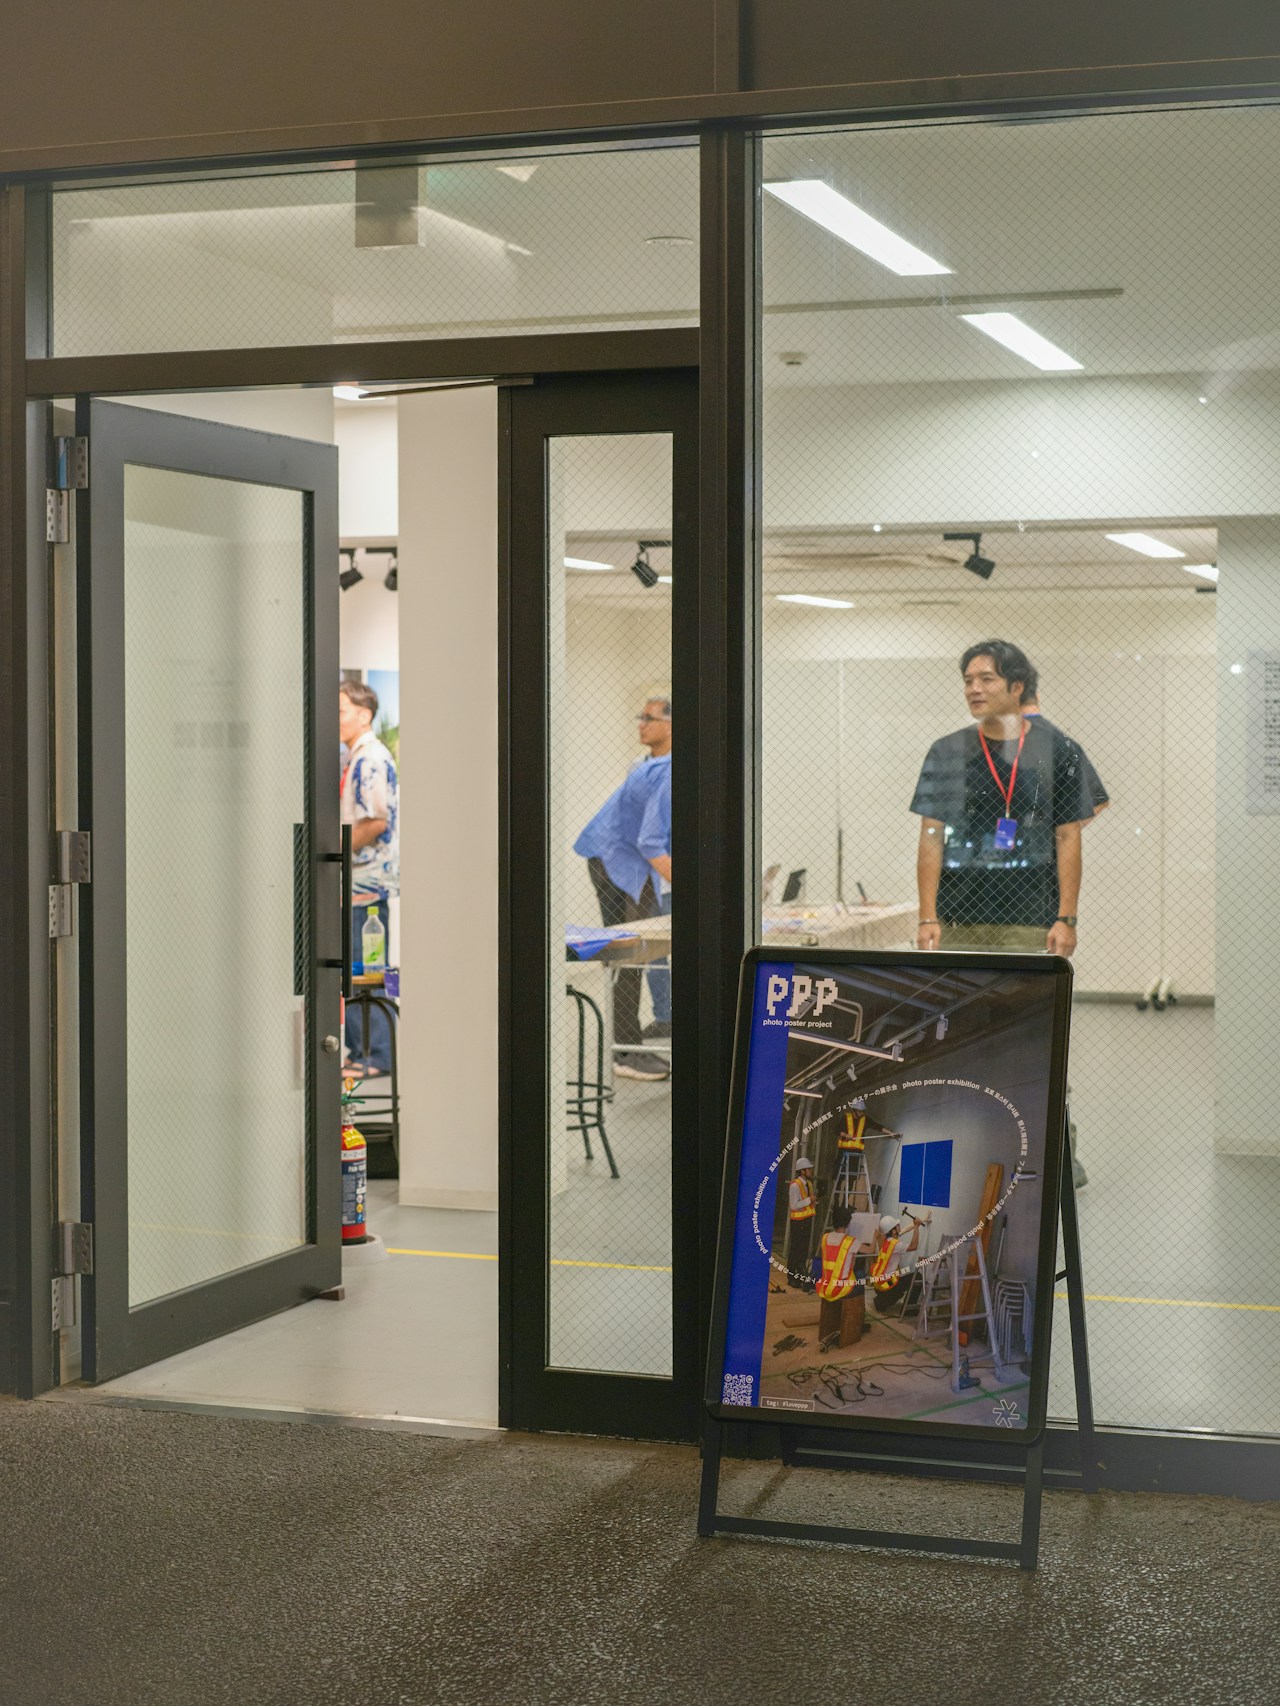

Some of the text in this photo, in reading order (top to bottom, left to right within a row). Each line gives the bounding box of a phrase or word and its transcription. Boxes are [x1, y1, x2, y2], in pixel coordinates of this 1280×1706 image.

[836, 1084, 898, 1112] フォトポスターの展示会
[902, 1078, 981, 1090] photo poster exhibition
[752, 1176, 770, 1254] photo poster exhibition
[914, 1220, 984, 1268] photo poster exhibition
